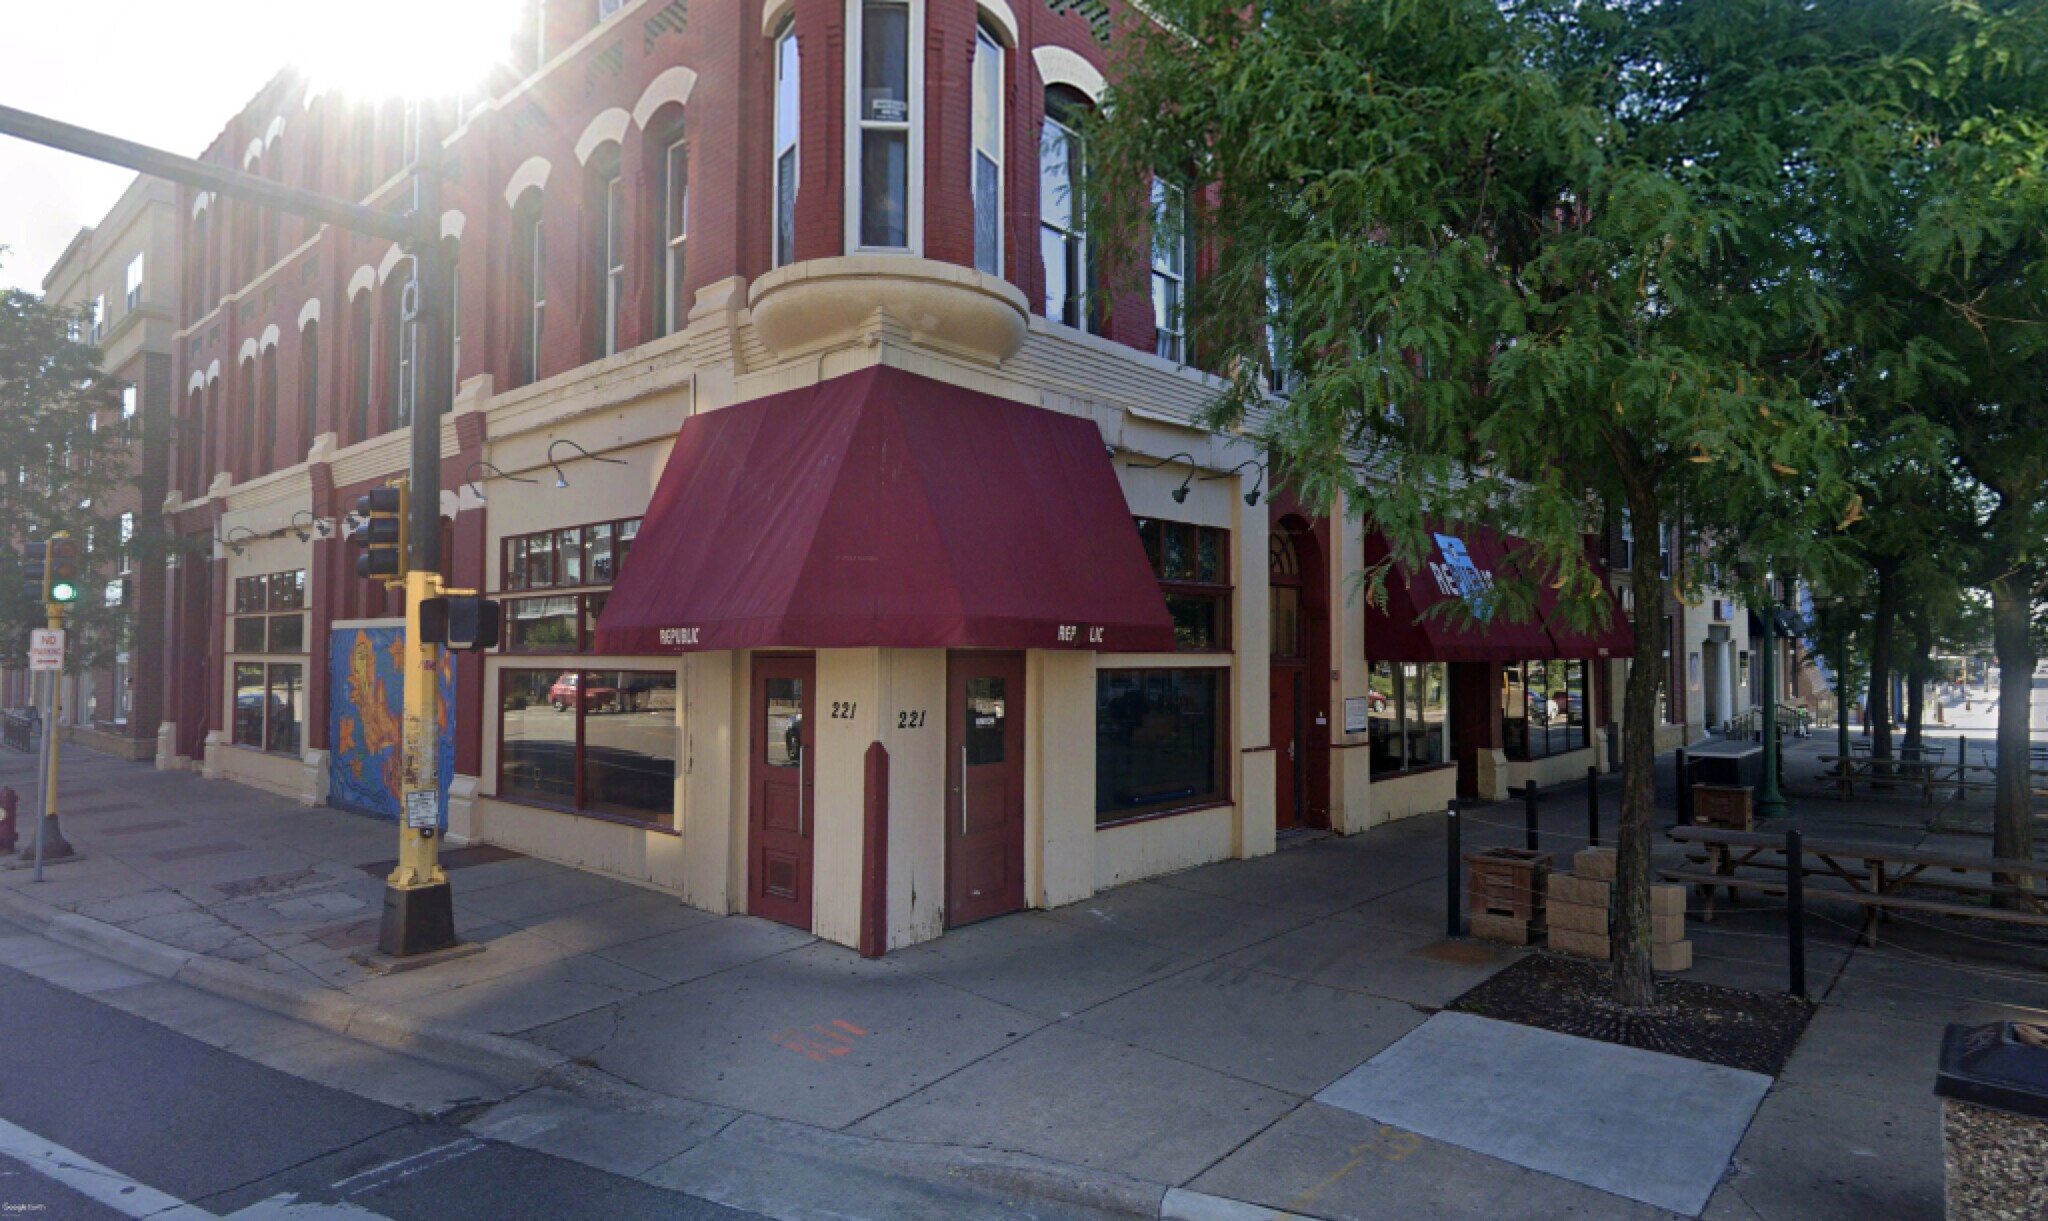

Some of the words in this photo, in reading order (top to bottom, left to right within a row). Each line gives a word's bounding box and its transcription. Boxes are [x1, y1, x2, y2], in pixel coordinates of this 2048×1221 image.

[41, 635, 57, 645] NO
[660, 627, 700, 645] REPUBLIC
[831, 701, 857, 719] 221
[898, 710, 926, 729] 221
